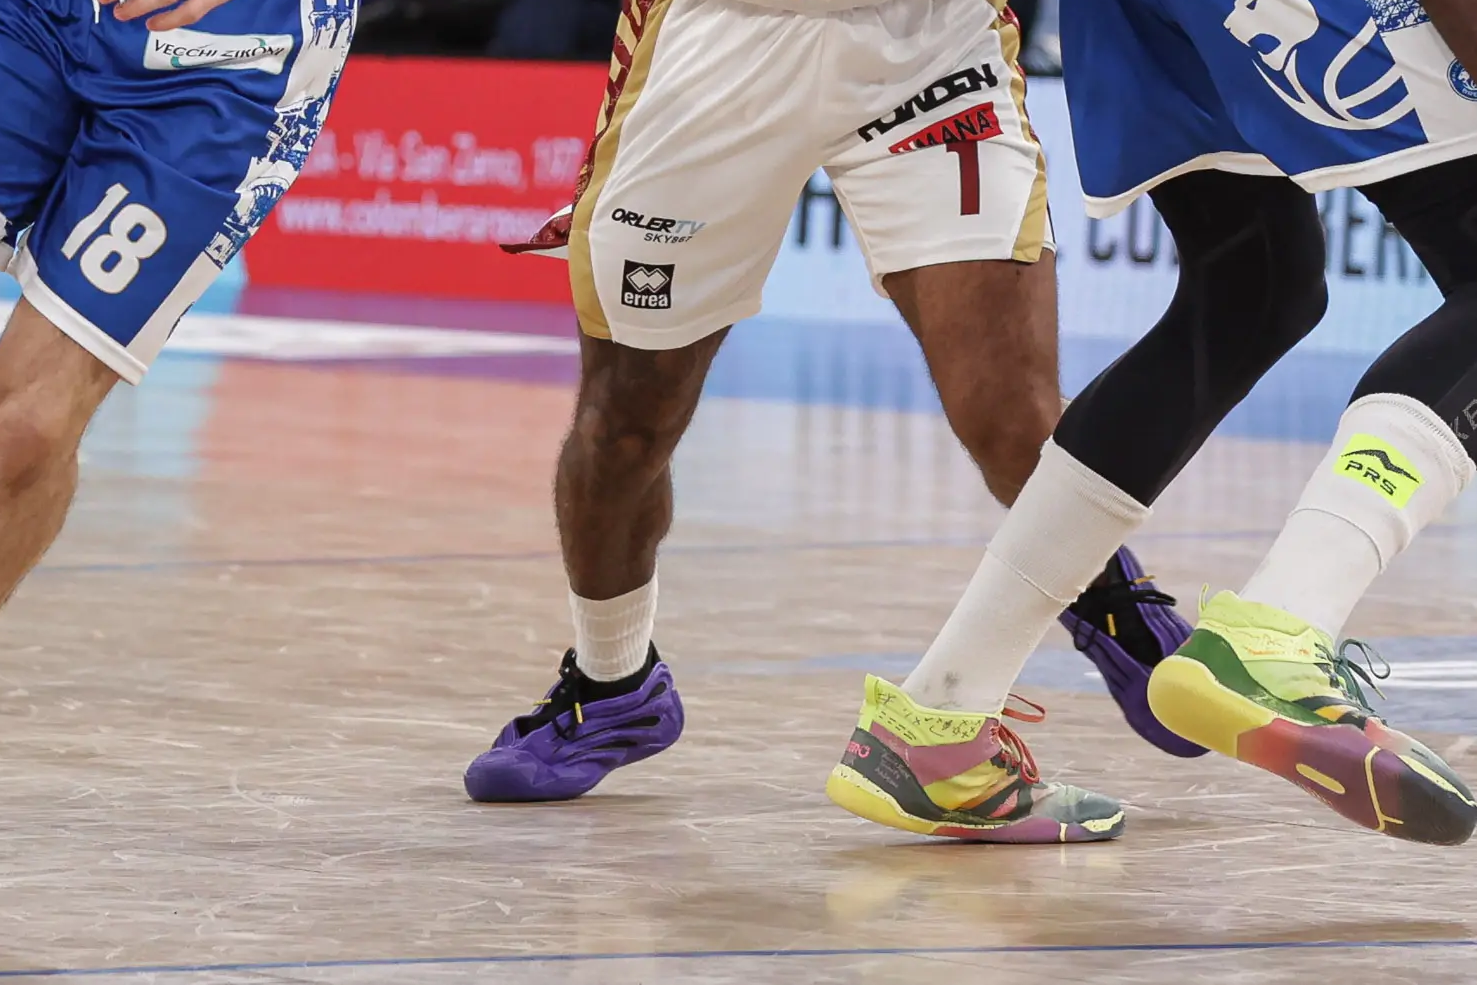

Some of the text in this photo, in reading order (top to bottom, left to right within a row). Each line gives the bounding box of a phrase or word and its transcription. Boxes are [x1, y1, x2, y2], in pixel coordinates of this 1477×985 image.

[155, 39, 218, 57] VECCHI
[946, 140, 981, 216] 1
[61, 183, 168, 295] 18
[624, 292, 669, 308] errea
[1345, 460, 1397, 496] PRS
